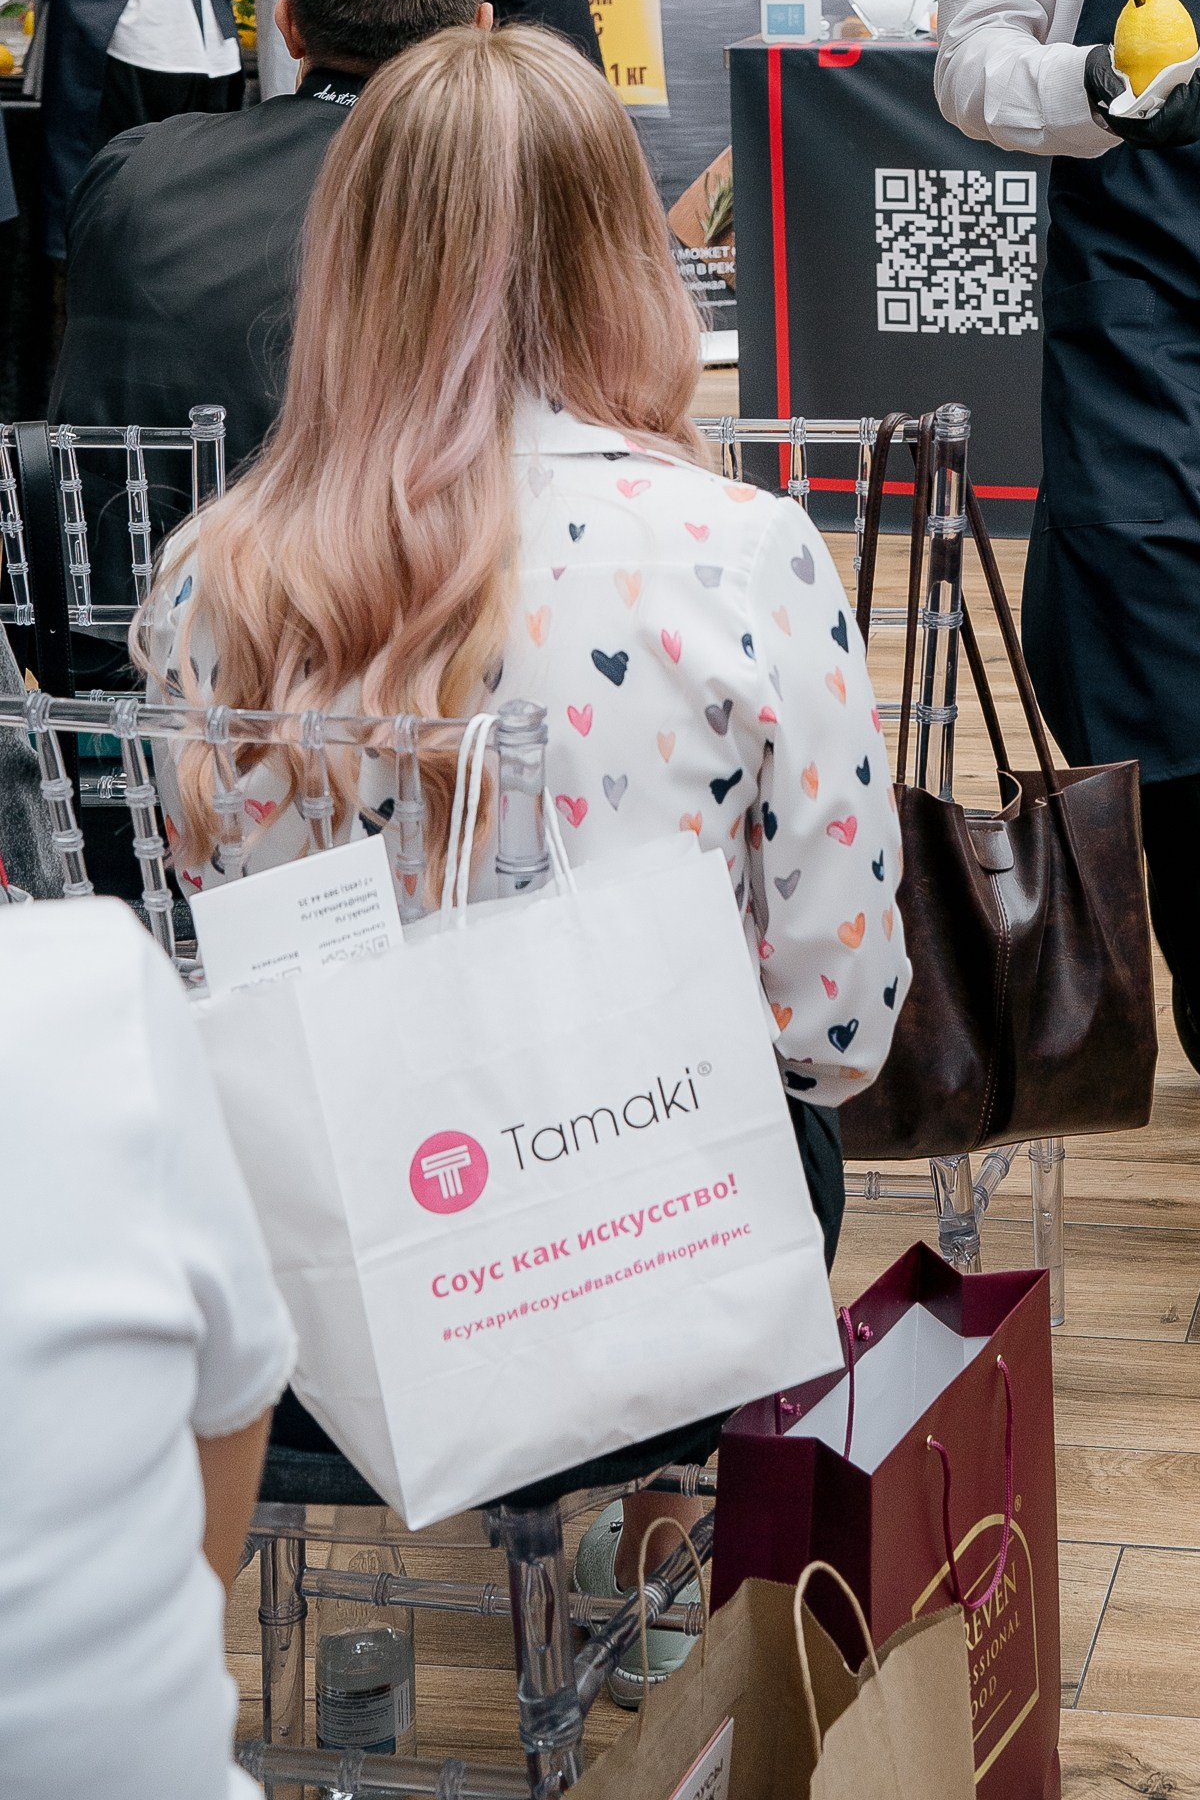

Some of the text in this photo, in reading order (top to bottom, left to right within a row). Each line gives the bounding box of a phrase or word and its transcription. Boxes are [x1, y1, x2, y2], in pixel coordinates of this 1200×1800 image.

[611, 63, 620, 86] 1
[501, 1067, 700, 1170] Tamaki
[431, 1172, 739, 1298] Соус как искусство!
[969, 1610, 1021, 1685] SSIONAL
